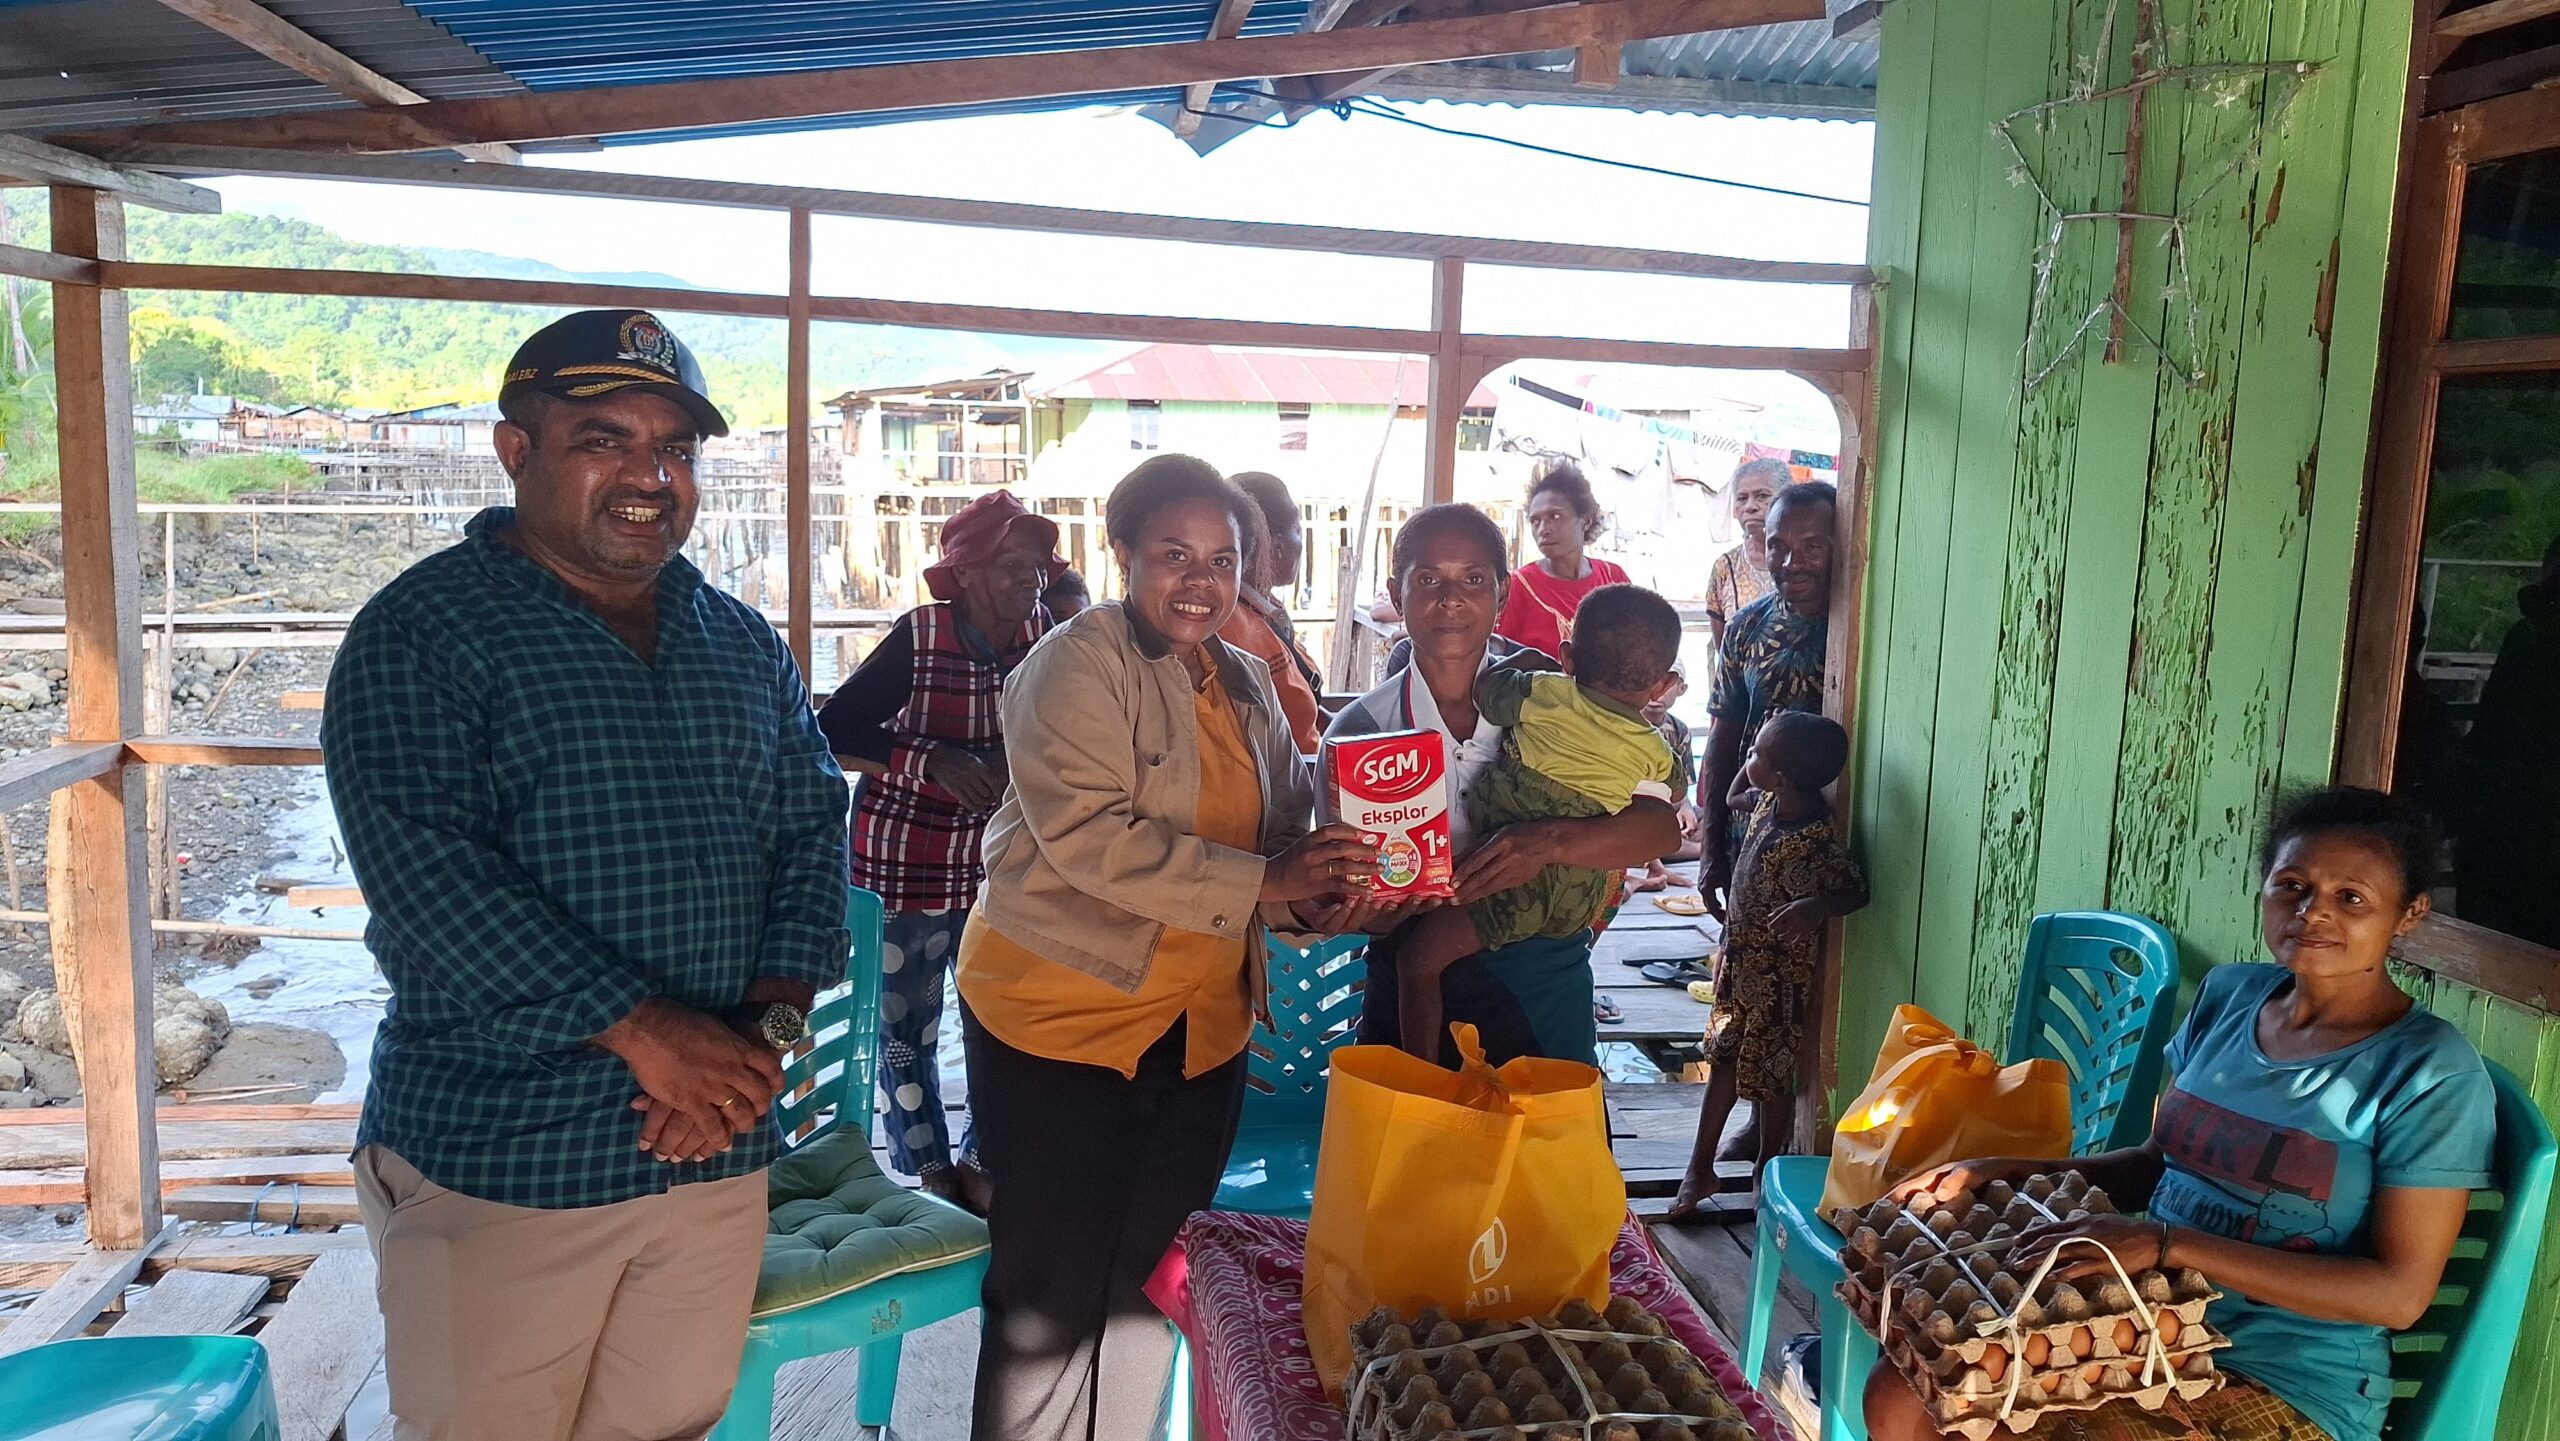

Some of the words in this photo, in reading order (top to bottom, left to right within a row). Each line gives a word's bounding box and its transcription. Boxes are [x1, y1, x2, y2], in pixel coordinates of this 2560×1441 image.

[1363, 749, 1418, 786] SGM
[1361, 805, 1428, 826] Eksplor
[1421, 829, 1448, 857] 1+
